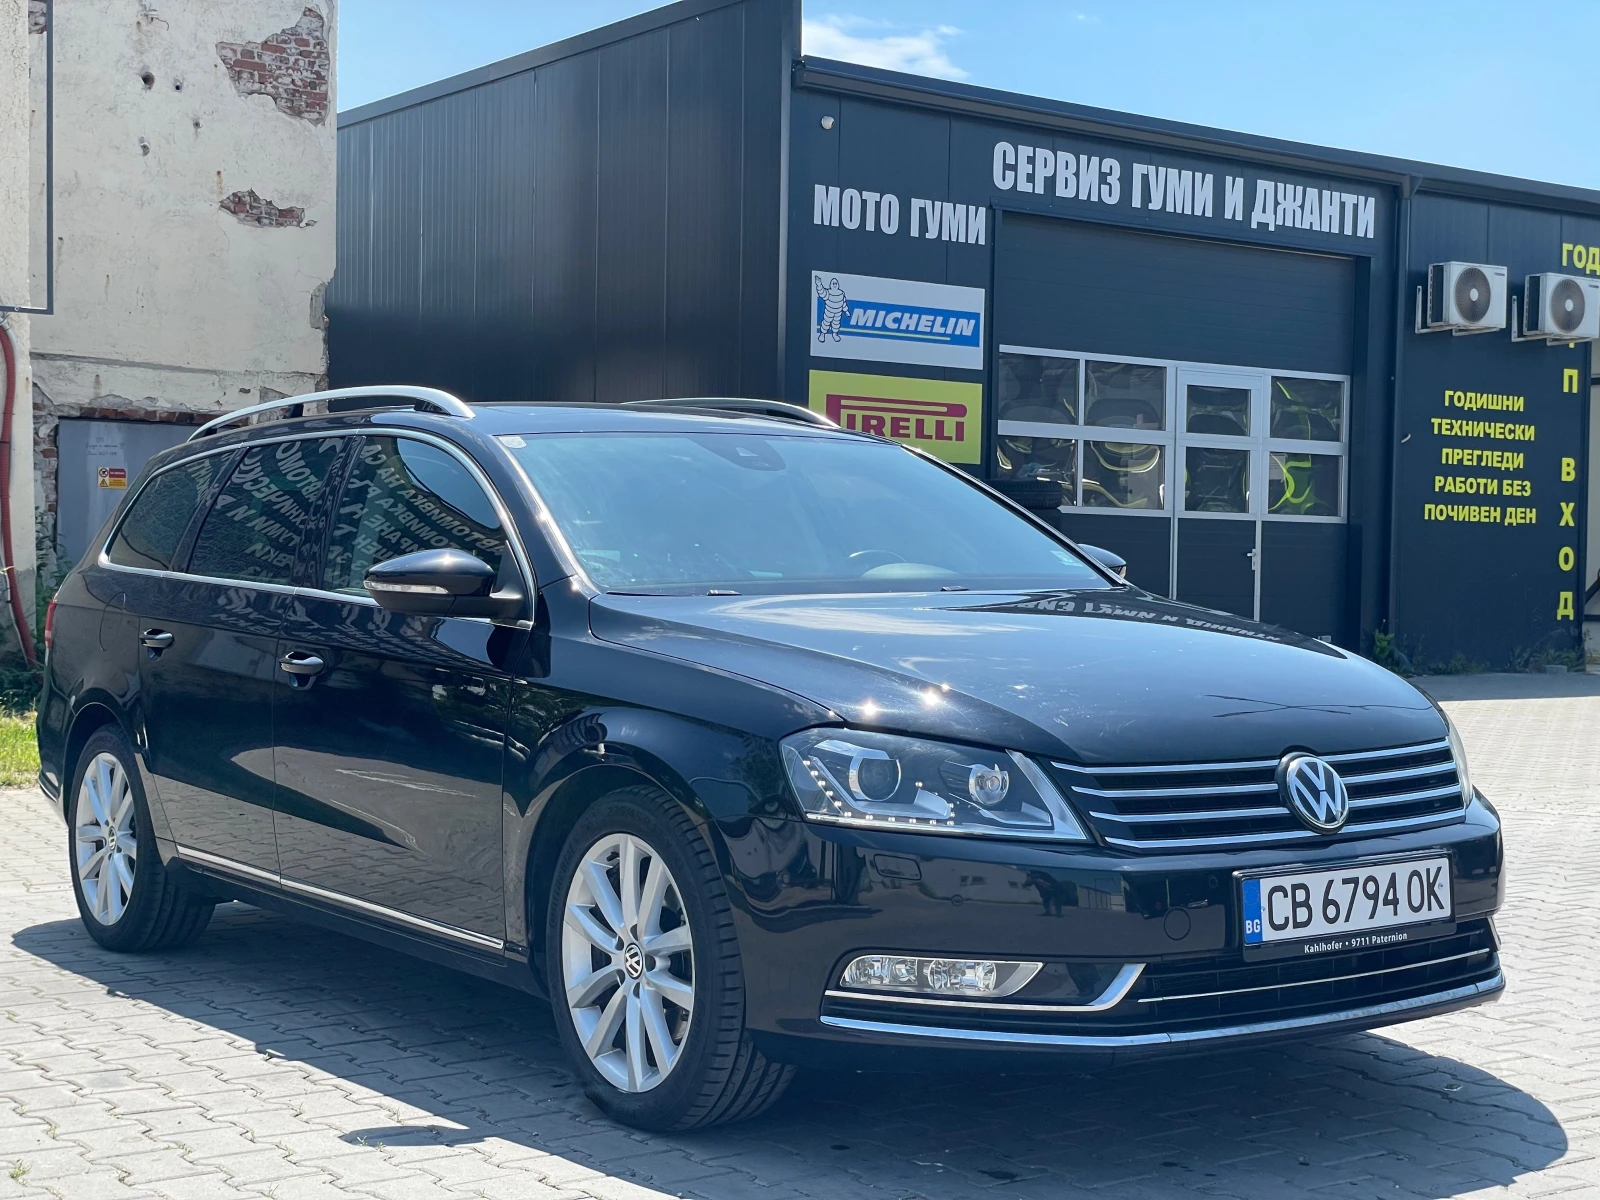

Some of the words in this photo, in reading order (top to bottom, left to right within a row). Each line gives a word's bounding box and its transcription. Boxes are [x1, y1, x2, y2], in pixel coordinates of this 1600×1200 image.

[992, 141, 1121, 205] СЕРВИЗ
[1131, 162, 1214, 218] ГУМИ
[1224, 175, 1244, 221] И
[1250, 179, 1376, 239] ДЖАНТИ
[813, 184, 900, 235] МОТО
[910, 197, 986, 246] ГУМИ
[1562, 243, 1600, 275] ГОД
[849, 308, 976, 337] MICHELIN
[1444, 390, 1525, 411] ГОДИШНИ
[825, 393, 968, 442] PIRELLI
[1431, 417, 1535, 441] ТЕХНИЧЕСКИ
[1441, 447, 1524, 470] ПРЕГЛЕДИ
[1434, 475, 1498, 495] РАБОТИ
[1502, 479, 1531, 497] БЕЗ
[1424, 503, 1501, 523] ПОЧИВЕН
[1504, 507, 1537, 526] ДЕН
[1557, 457, 1577, 621] ВХОД
[1267, 882, 1313, 932] CB
[1321, 872, 1400, 925] 6794
[1406, 866, 1445, 914] OK
[1245, 919, 1261, 934] BG
[1304, 941, 1343, 954] Kahlhofer
[1351, 937, 1370, 947] 9711
[1371, 932, 1408, 945] Paternion
